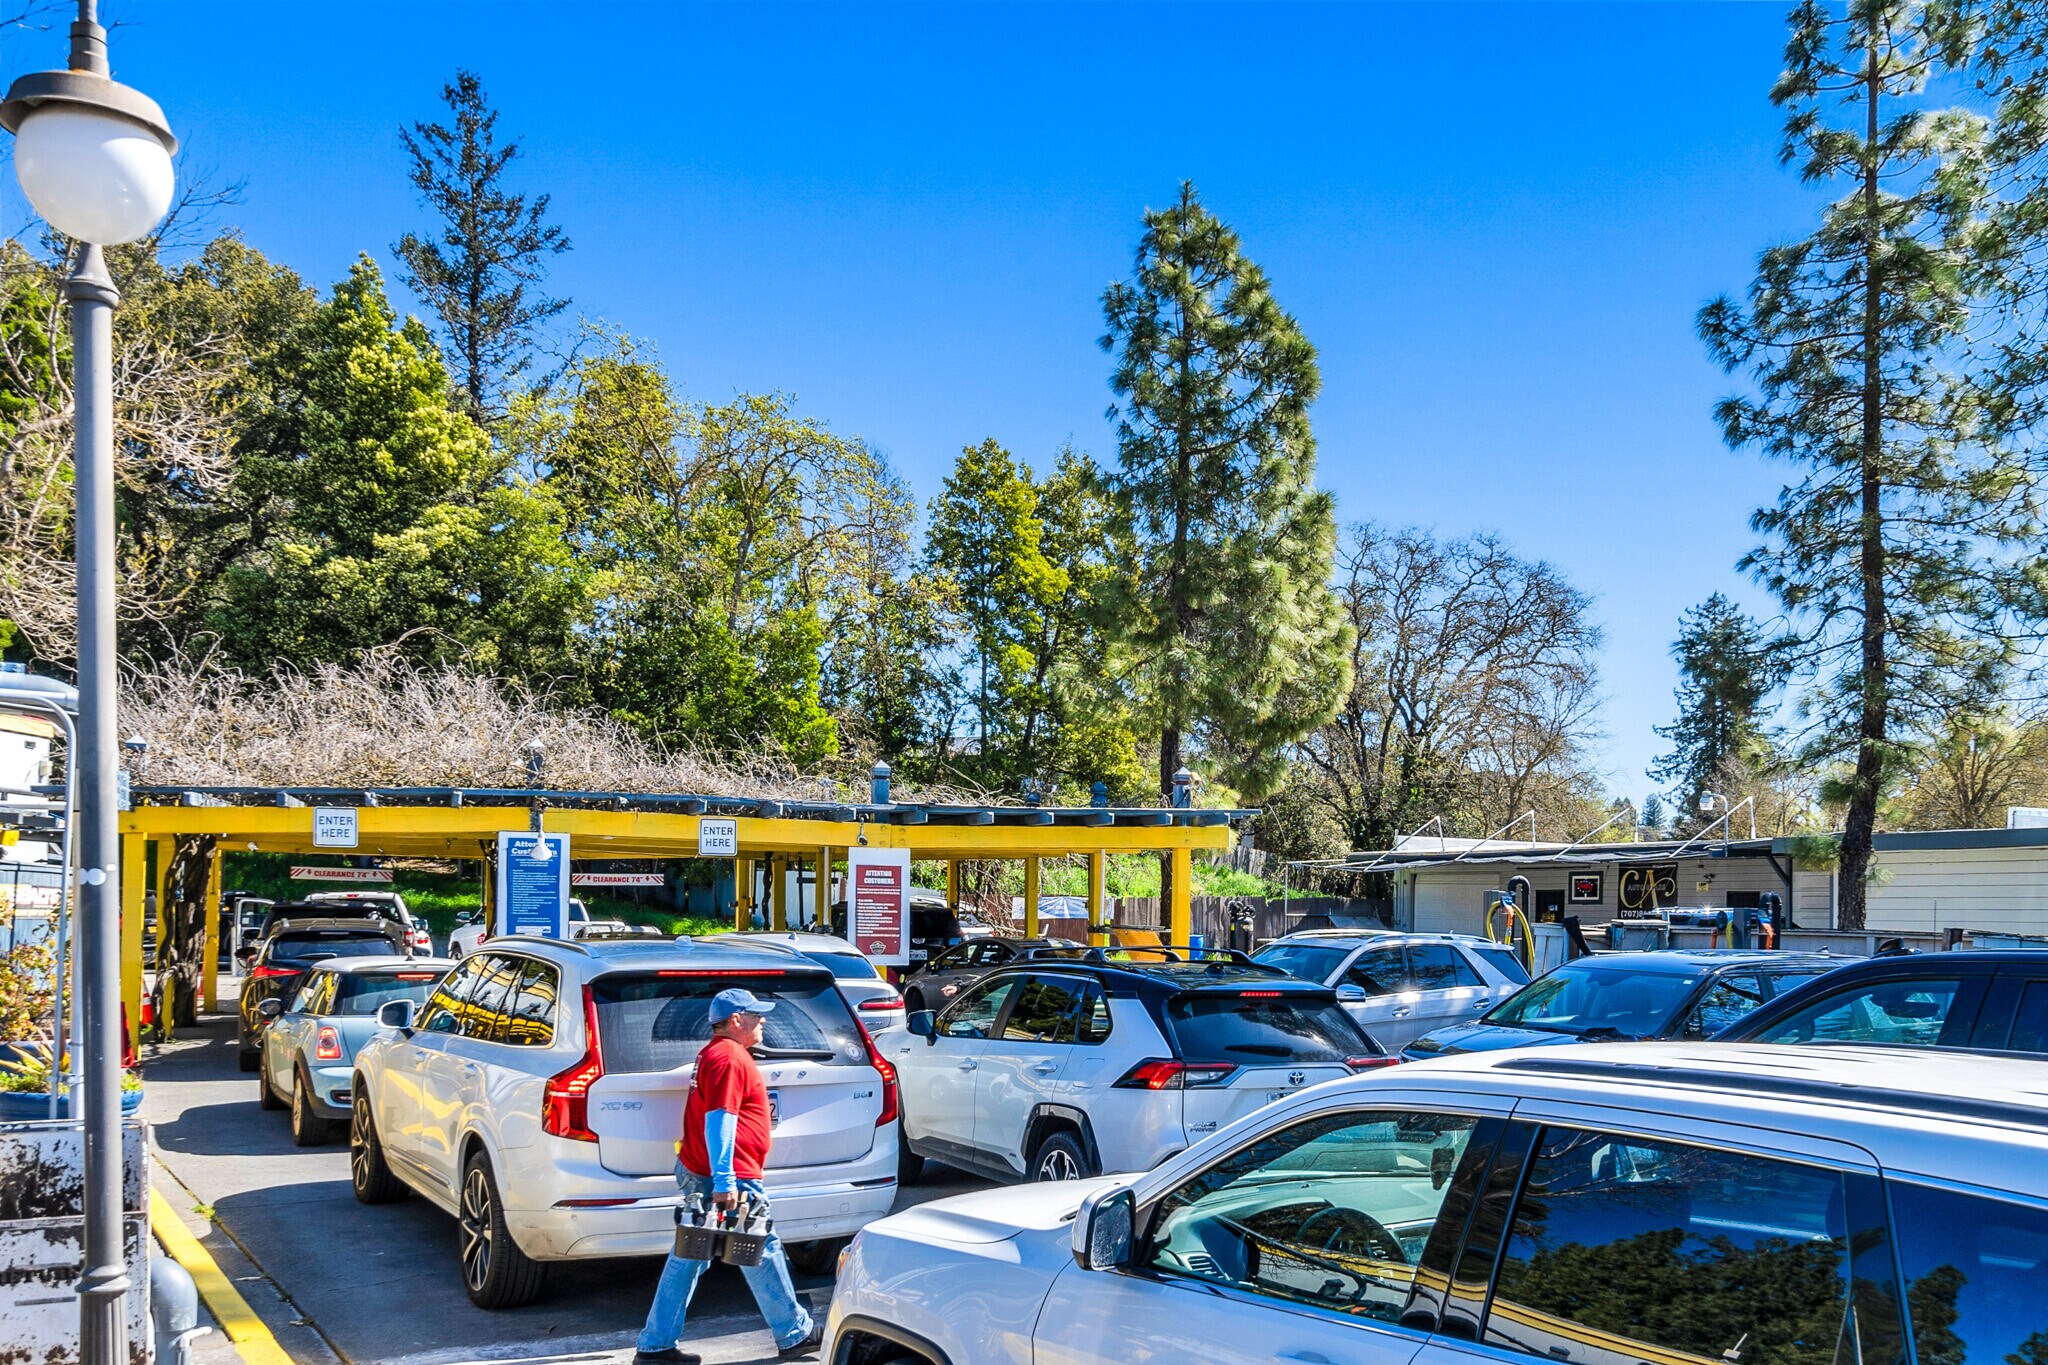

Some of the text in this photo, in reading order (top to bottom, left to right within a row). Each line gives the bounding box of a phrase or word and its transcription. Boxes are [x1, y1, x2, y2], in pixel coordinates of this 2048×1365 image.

[318, 816, 354, 826] ENTER
[321, 828, 351, 838] HERE
[703, 826, 733, 836] ENTER
[514, 840, 555, 848] Attenon
[705, 838, 731, 847] HERE
[314, 870, 355, 878] CLEARANCE
